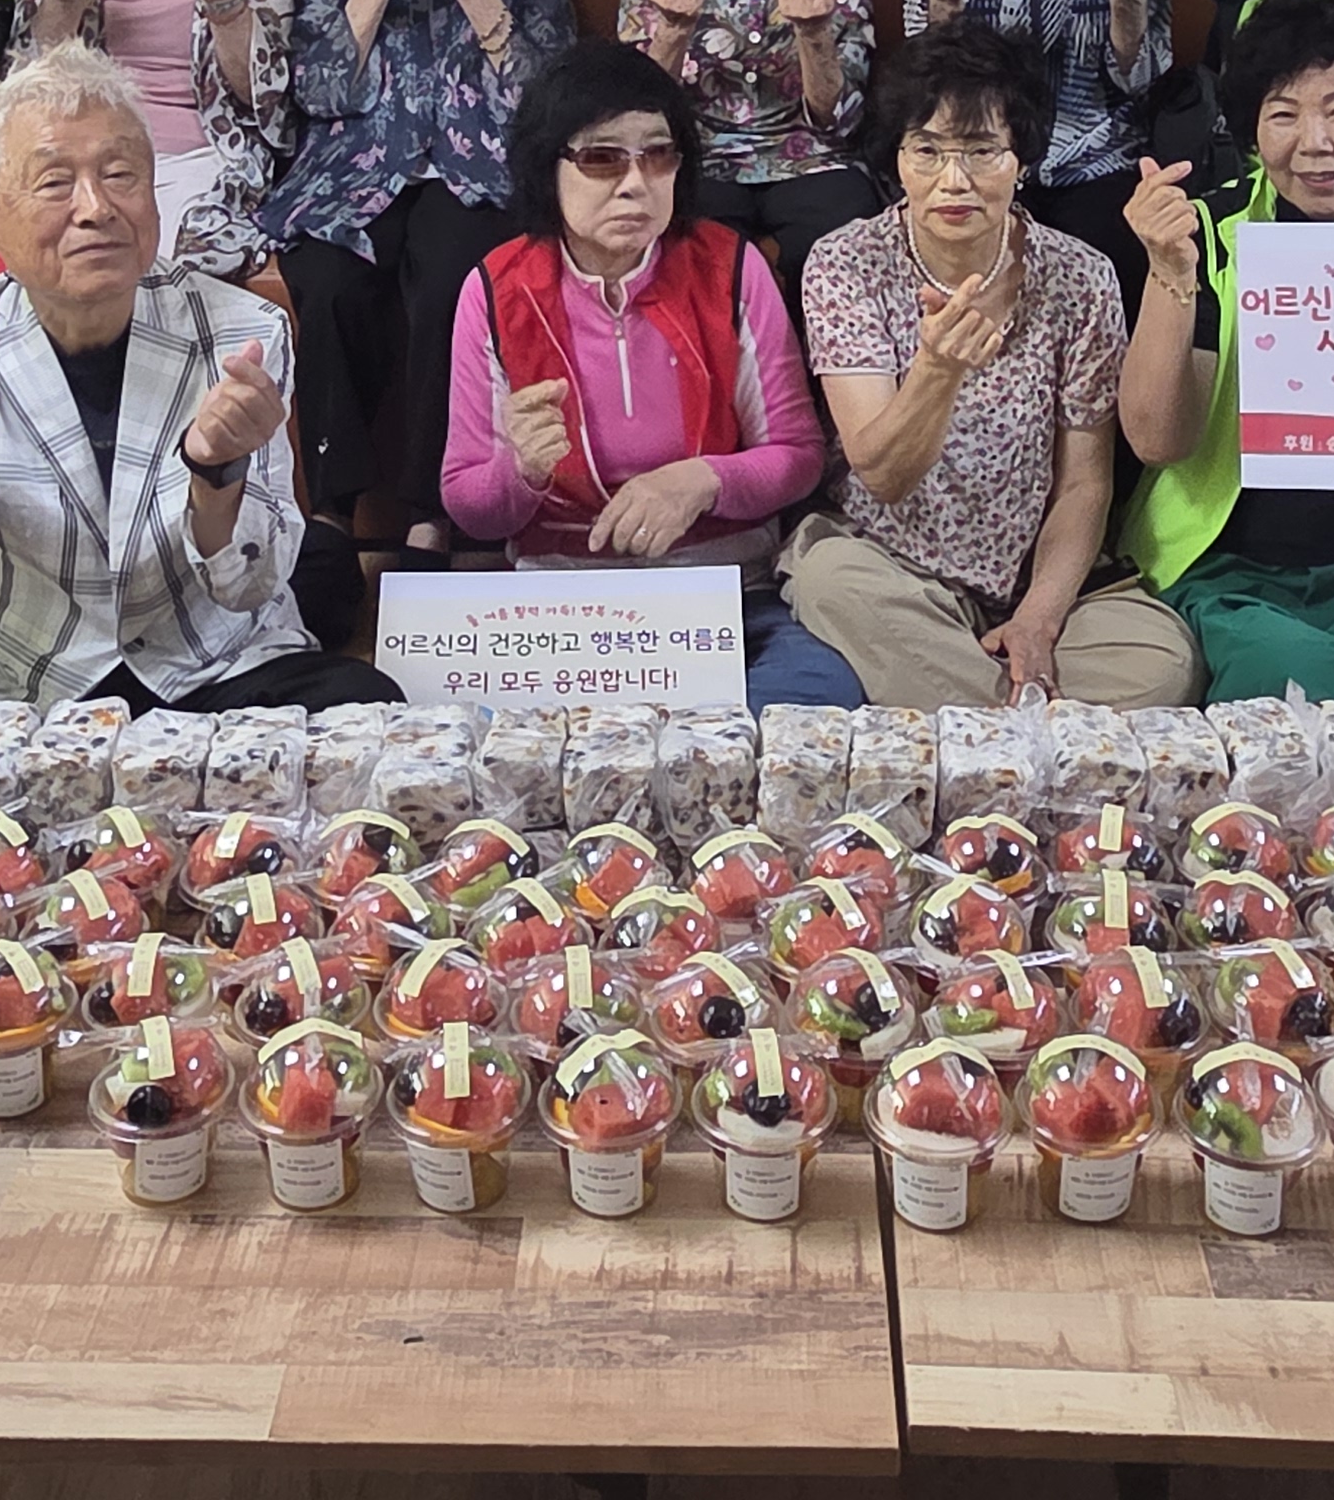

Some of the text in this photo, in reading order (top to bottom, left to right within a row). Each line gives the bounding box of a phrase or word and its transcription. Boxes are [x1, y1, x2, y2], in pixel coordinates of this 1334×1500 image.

[1241, 285, 1332, 322] 어르신
[1283, 435, 1314, 451] 후원
[384, 627, 736, 657] 어르신의 건강하고 행복한 여름을
[443, 667, 678, 695] 우리 모두 응원합니다!
